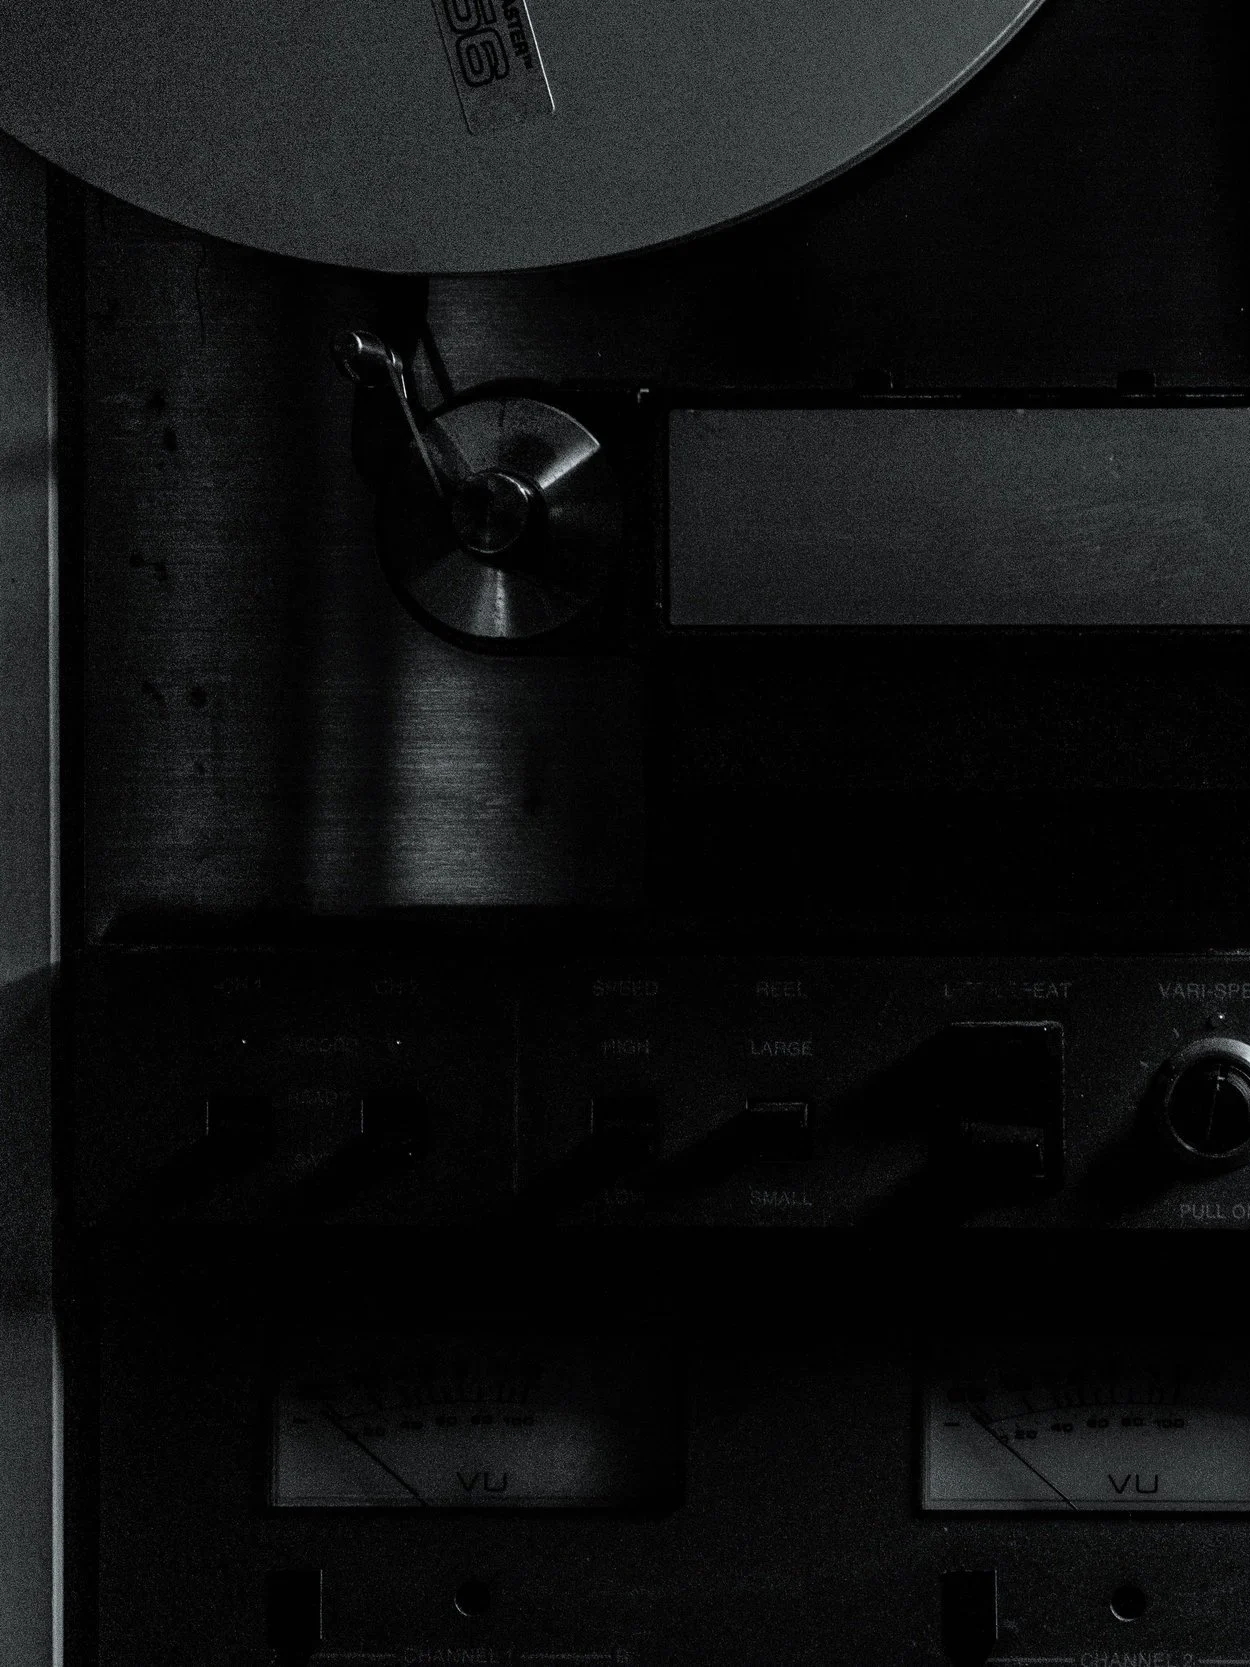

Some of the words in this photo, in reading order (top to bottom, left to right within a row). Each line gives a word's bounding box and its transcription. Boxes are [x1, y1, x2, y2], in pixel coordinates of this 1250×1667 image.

[750, 1040, 813, 1057] LARGE
[750, 1190, 813, 1207] SMALL
[1179, 1204, 1225, 1220] PULL
[456, 1472, 509, 1492] VU
[1107, 1473, 1160, 1494] VU
